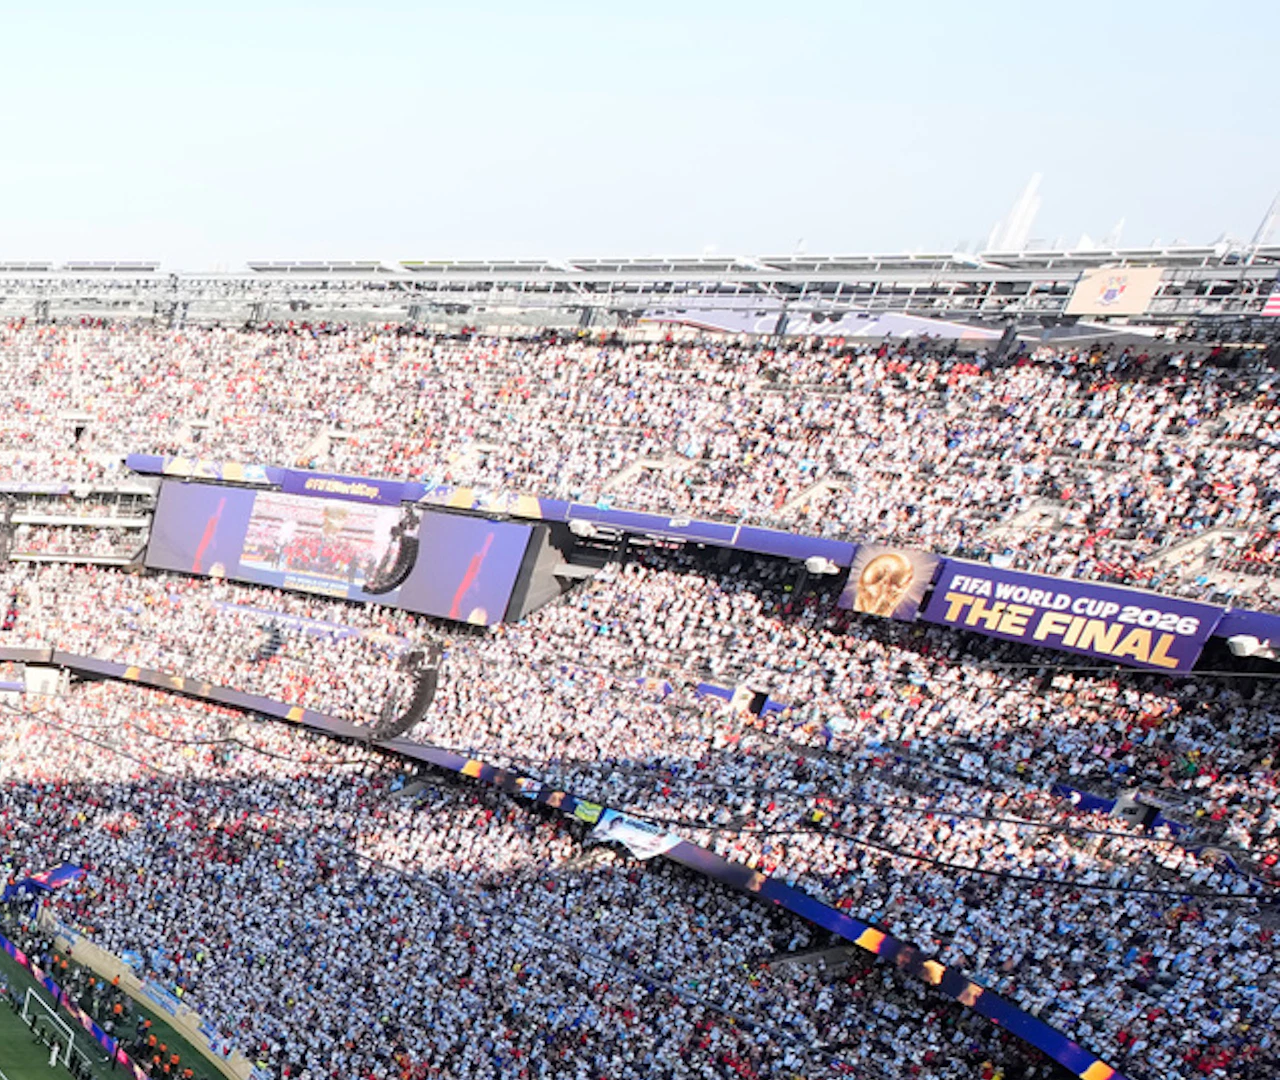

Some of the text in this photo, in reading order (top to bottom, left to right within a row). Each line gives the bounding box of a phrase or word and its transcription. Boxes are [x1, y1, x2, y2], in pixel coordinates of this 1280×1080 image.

[944, 592, 1180, 669] THE FINAL
[949, 575, 1200, 636] FIFA WORLD CUP 2026
